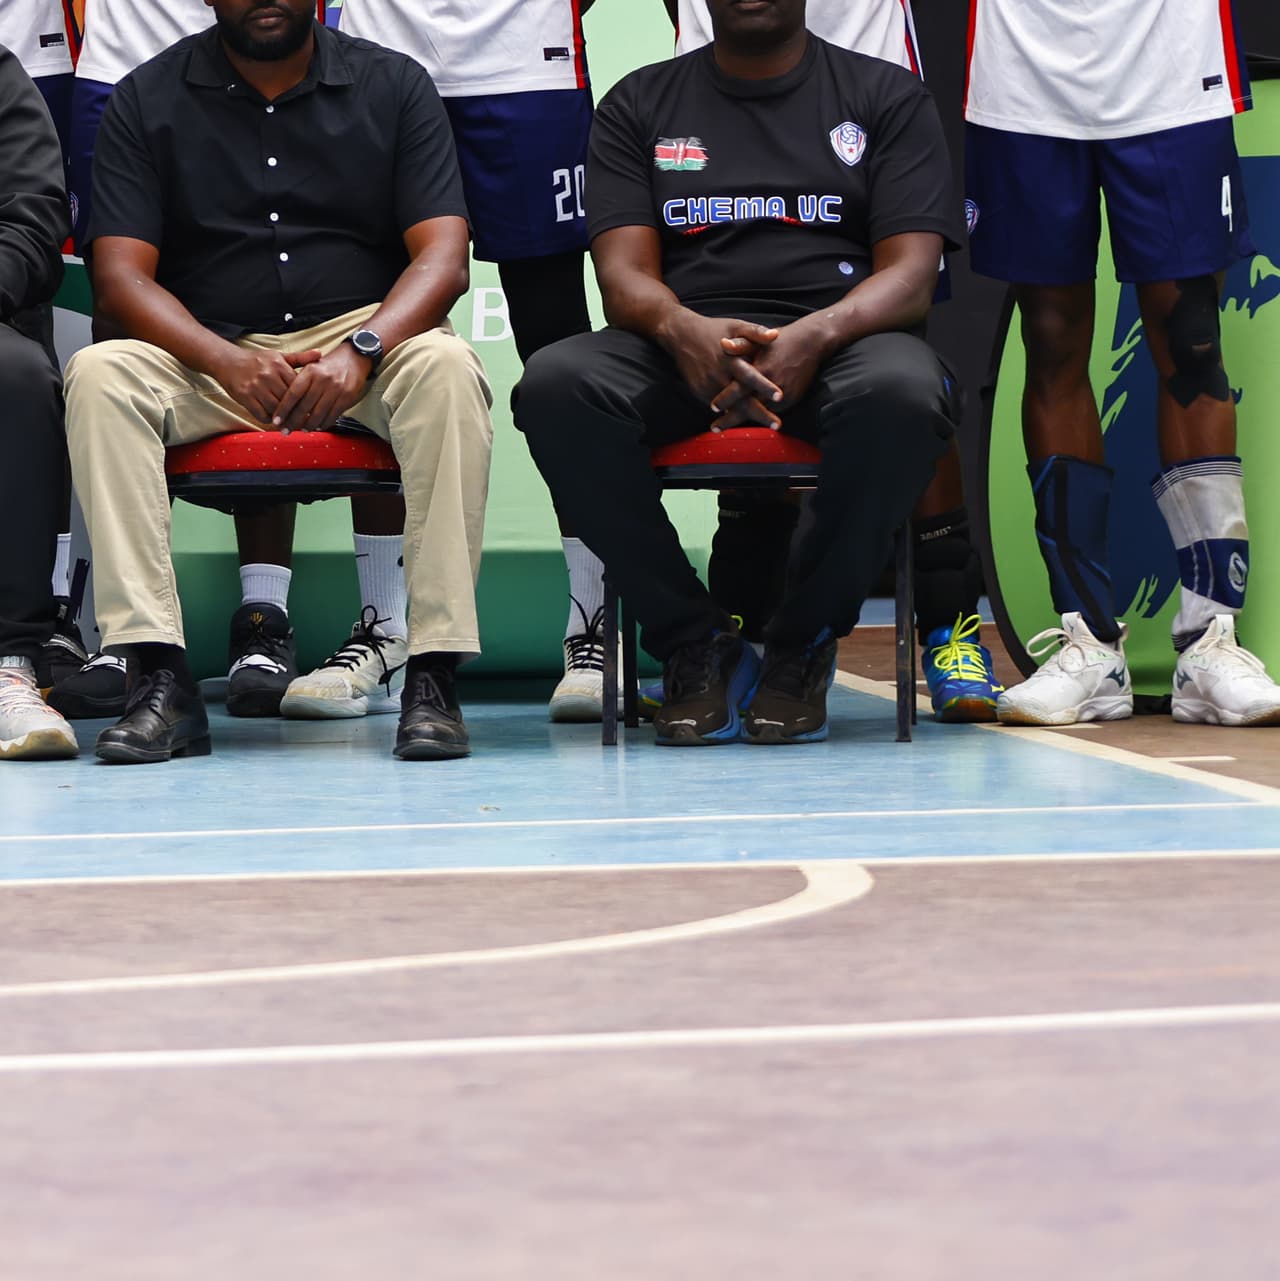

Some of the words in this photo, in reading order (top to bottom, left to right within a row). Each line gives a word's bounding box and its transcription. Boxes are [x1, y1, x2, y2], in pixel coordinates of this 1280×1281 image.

[662, 194, 786, 227] CHEMA
[797, 194, 843, 223] VC
[1220, 174, 1234, 233] 4
